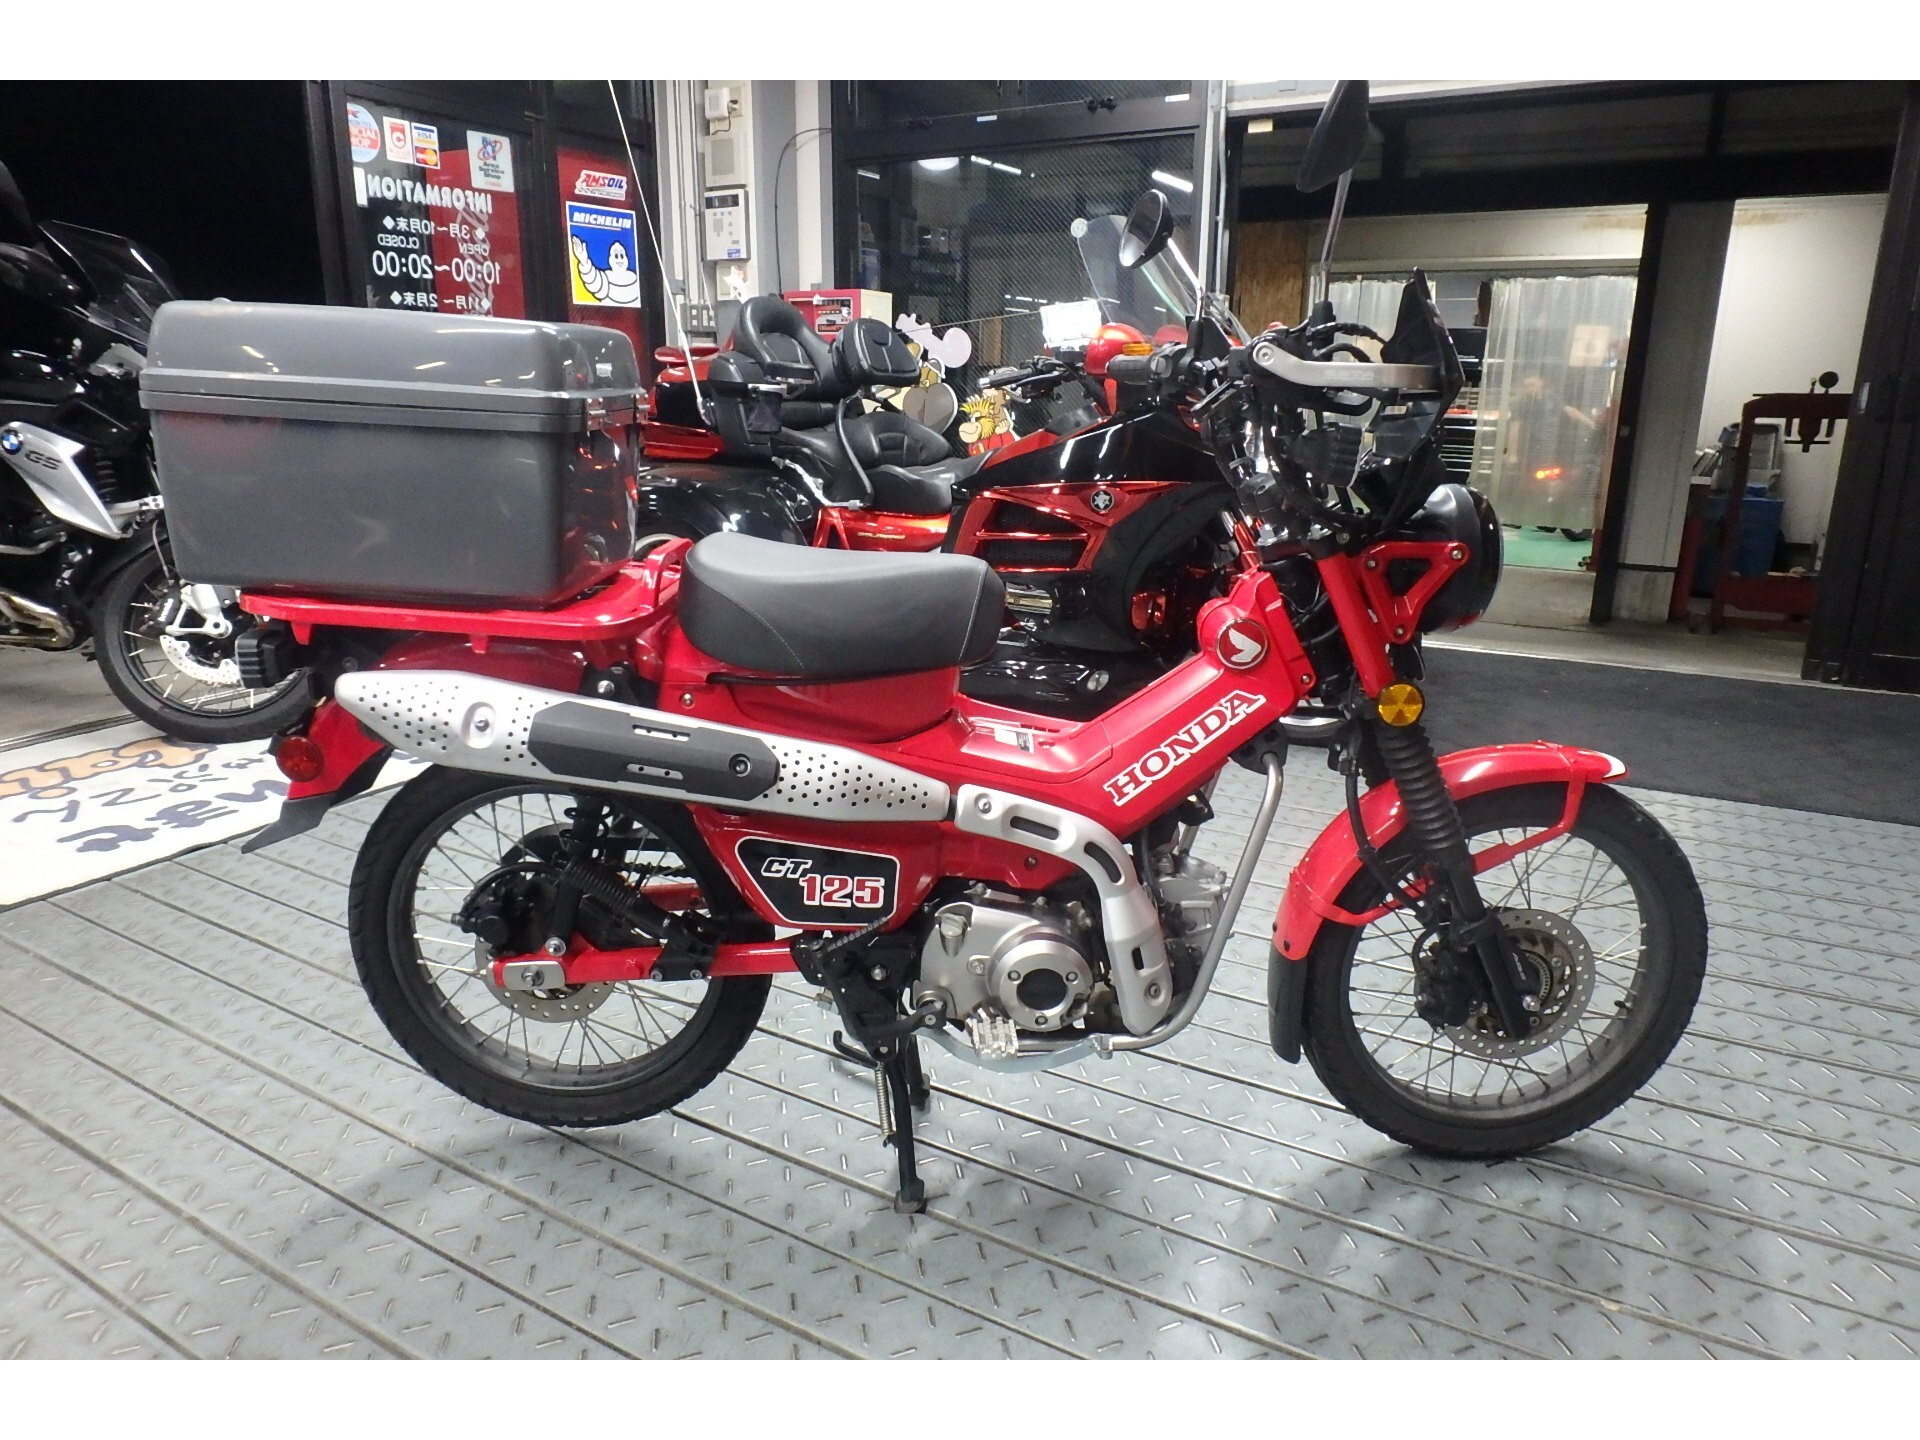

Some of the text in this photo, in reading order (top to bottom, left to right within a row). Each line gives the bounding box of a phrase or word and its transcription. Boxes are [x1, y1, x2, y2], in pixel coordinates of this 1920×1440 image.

[581, 173, 624, 189] AMSOIL
[573, 212, 632, 228] MICHELIN
[25, 450, 62, 470] GS
[1103, 690, 1267, 807] HONDA
[761, 857, 812, 878] CT
[799, 874, 885, 908] 125
